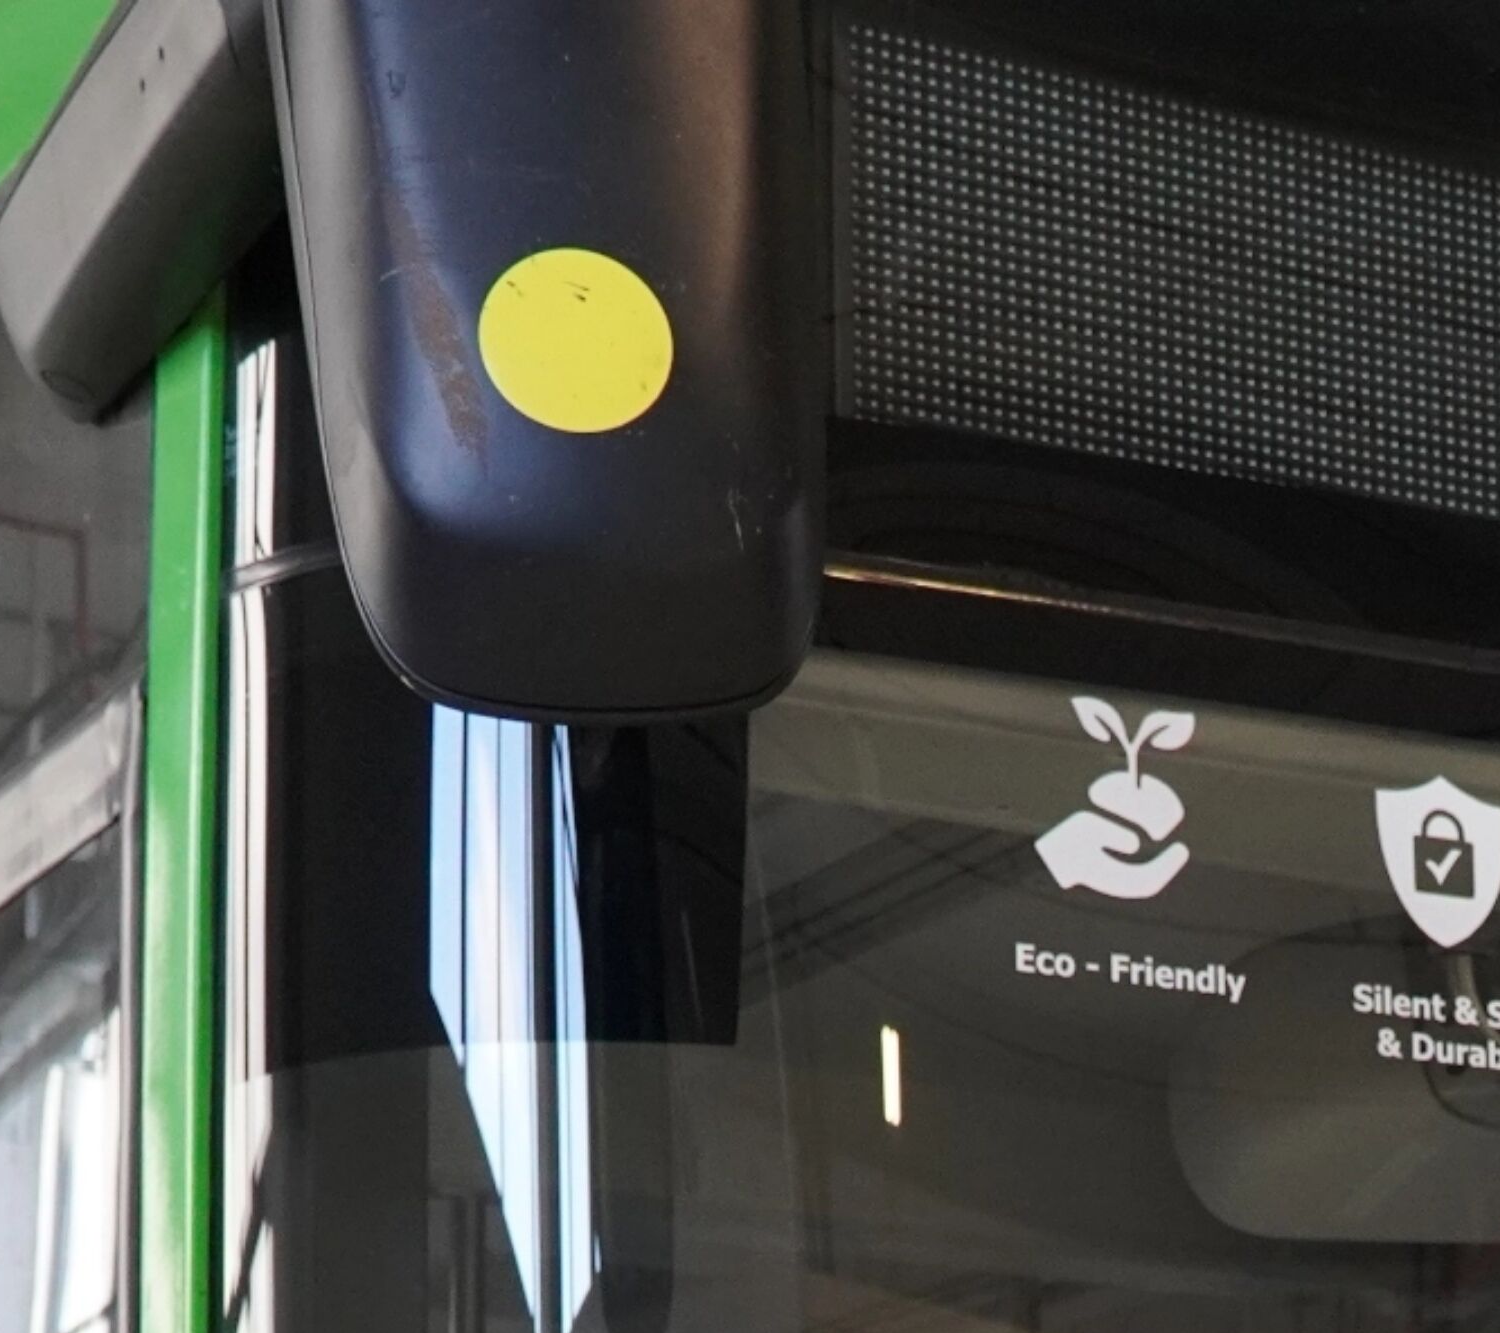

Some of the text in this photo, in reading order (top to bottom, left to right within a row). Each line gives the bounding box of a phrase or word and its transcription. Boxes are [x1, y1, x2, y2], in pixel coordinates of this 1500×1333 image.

[1014, 942, 1077, 979] Eco
[1109, 953, 1247, 1003] Friendly
[1352, 982, 1446, 1023] Silent
[1453, 994, 1480, 1026] &
[1377, 1026, 1403, 1059] &
